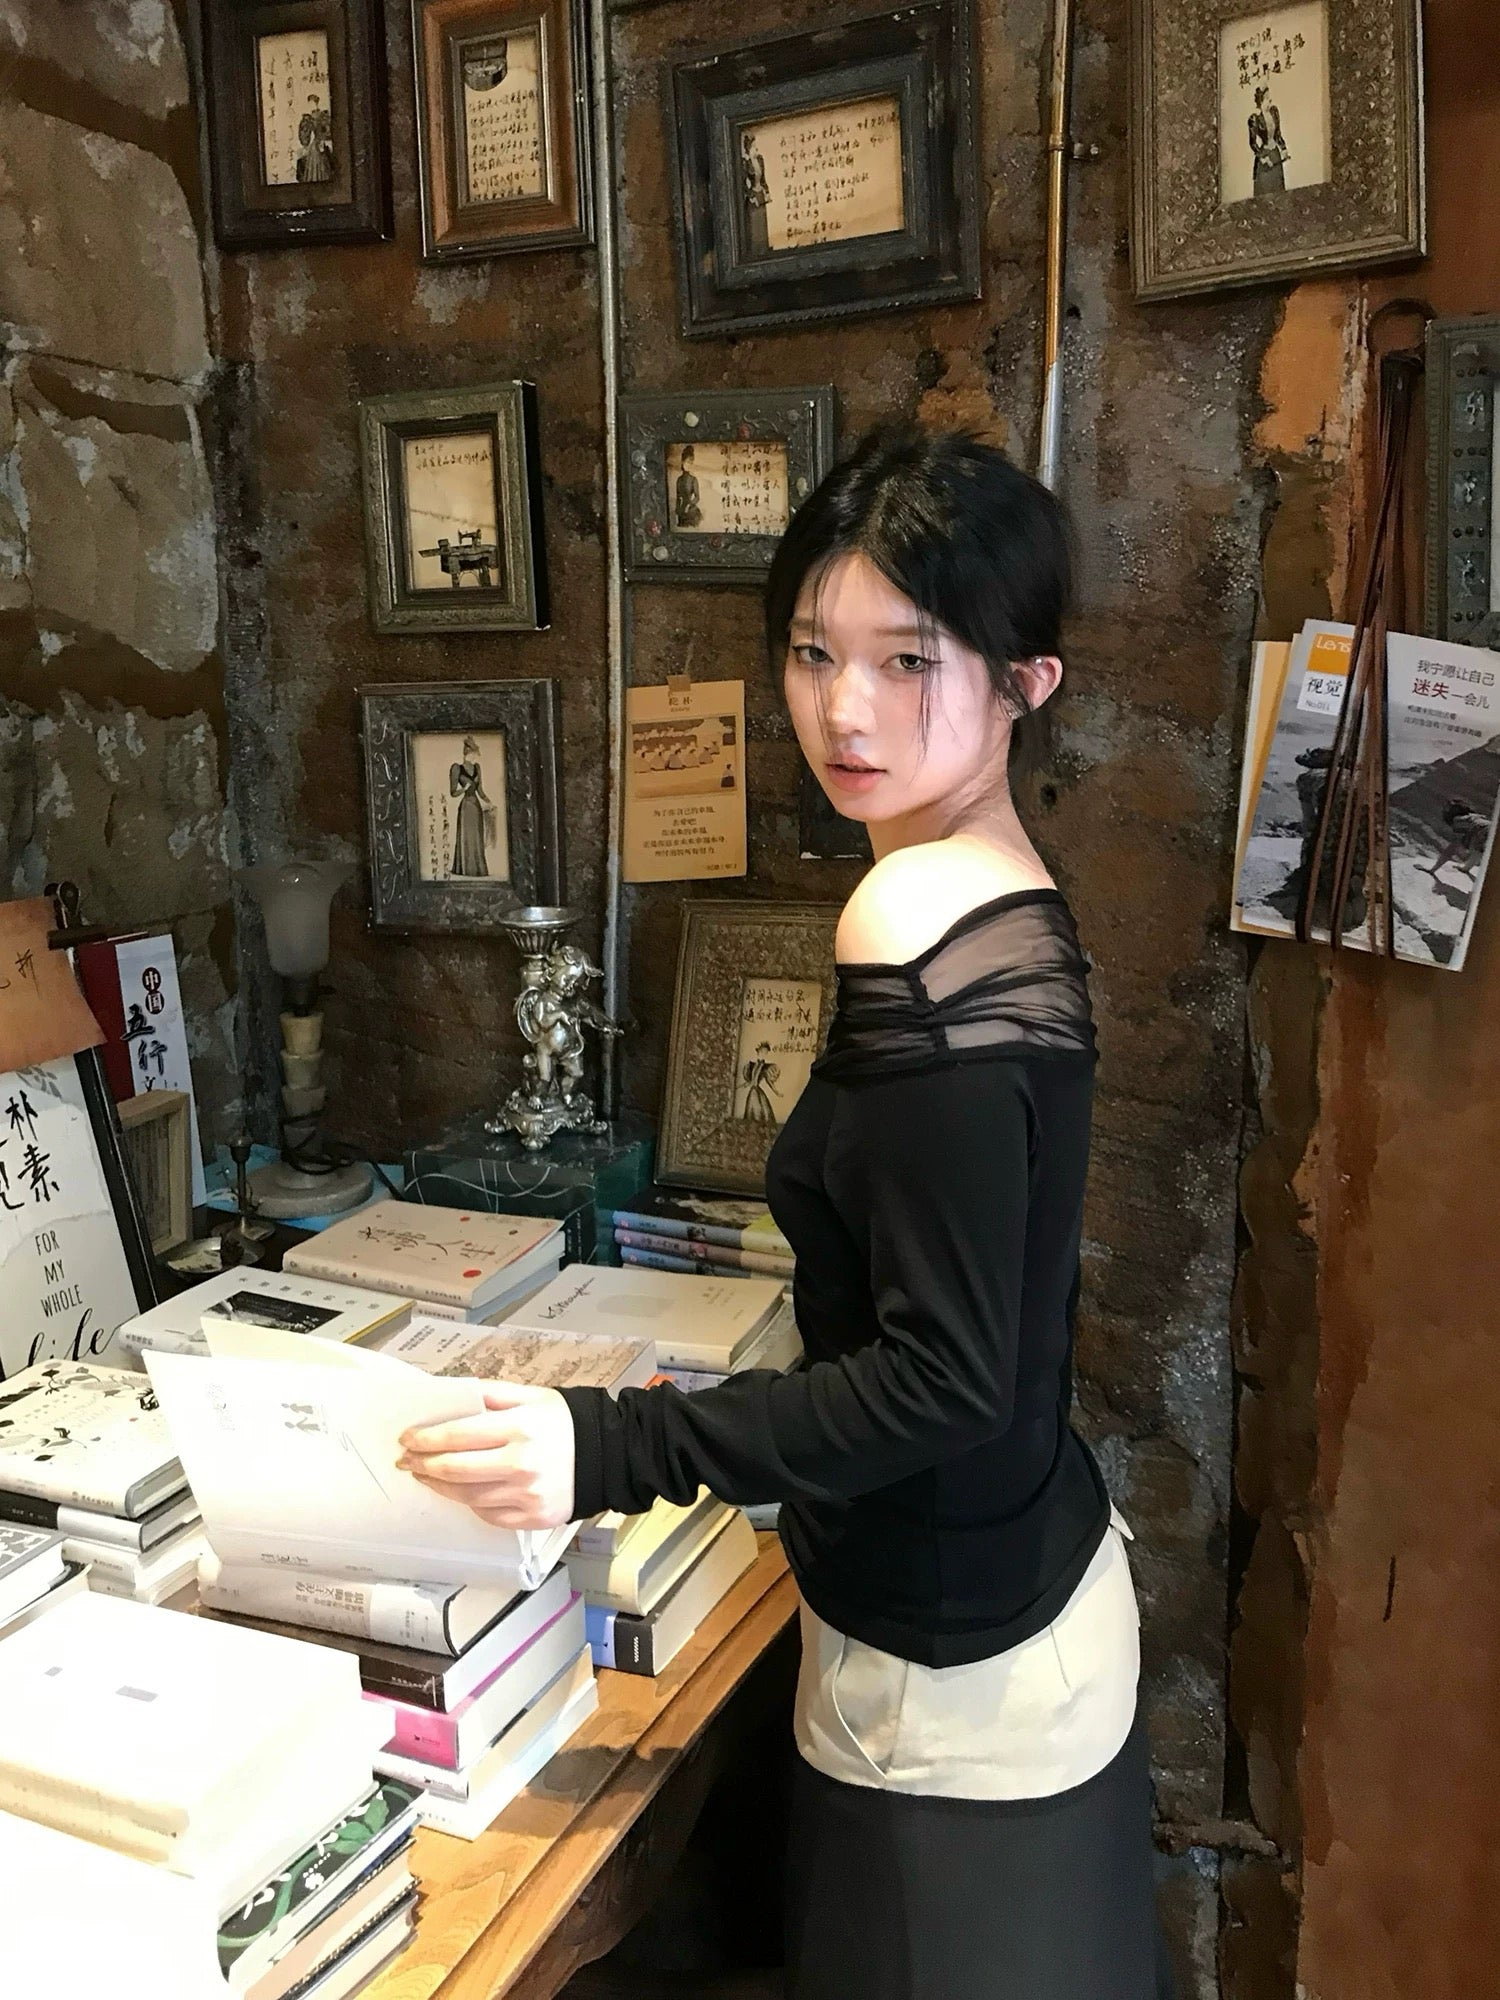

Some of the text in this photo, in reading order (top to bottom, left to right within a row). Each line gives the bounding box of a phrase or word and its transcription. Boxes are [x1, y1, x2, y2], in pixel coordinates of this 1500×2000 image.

[1307, 676, 1343, 697] 视觉
[1417, 659, 1495, 687] 我宁愿让自己
[1412, 677, 1490, 709] 迷失一会儿
[35, 1230, 60, 1256] FOR
[44, 1259, 65, 1285] MY
[40, 1284, 83, 1318] WHOLE
